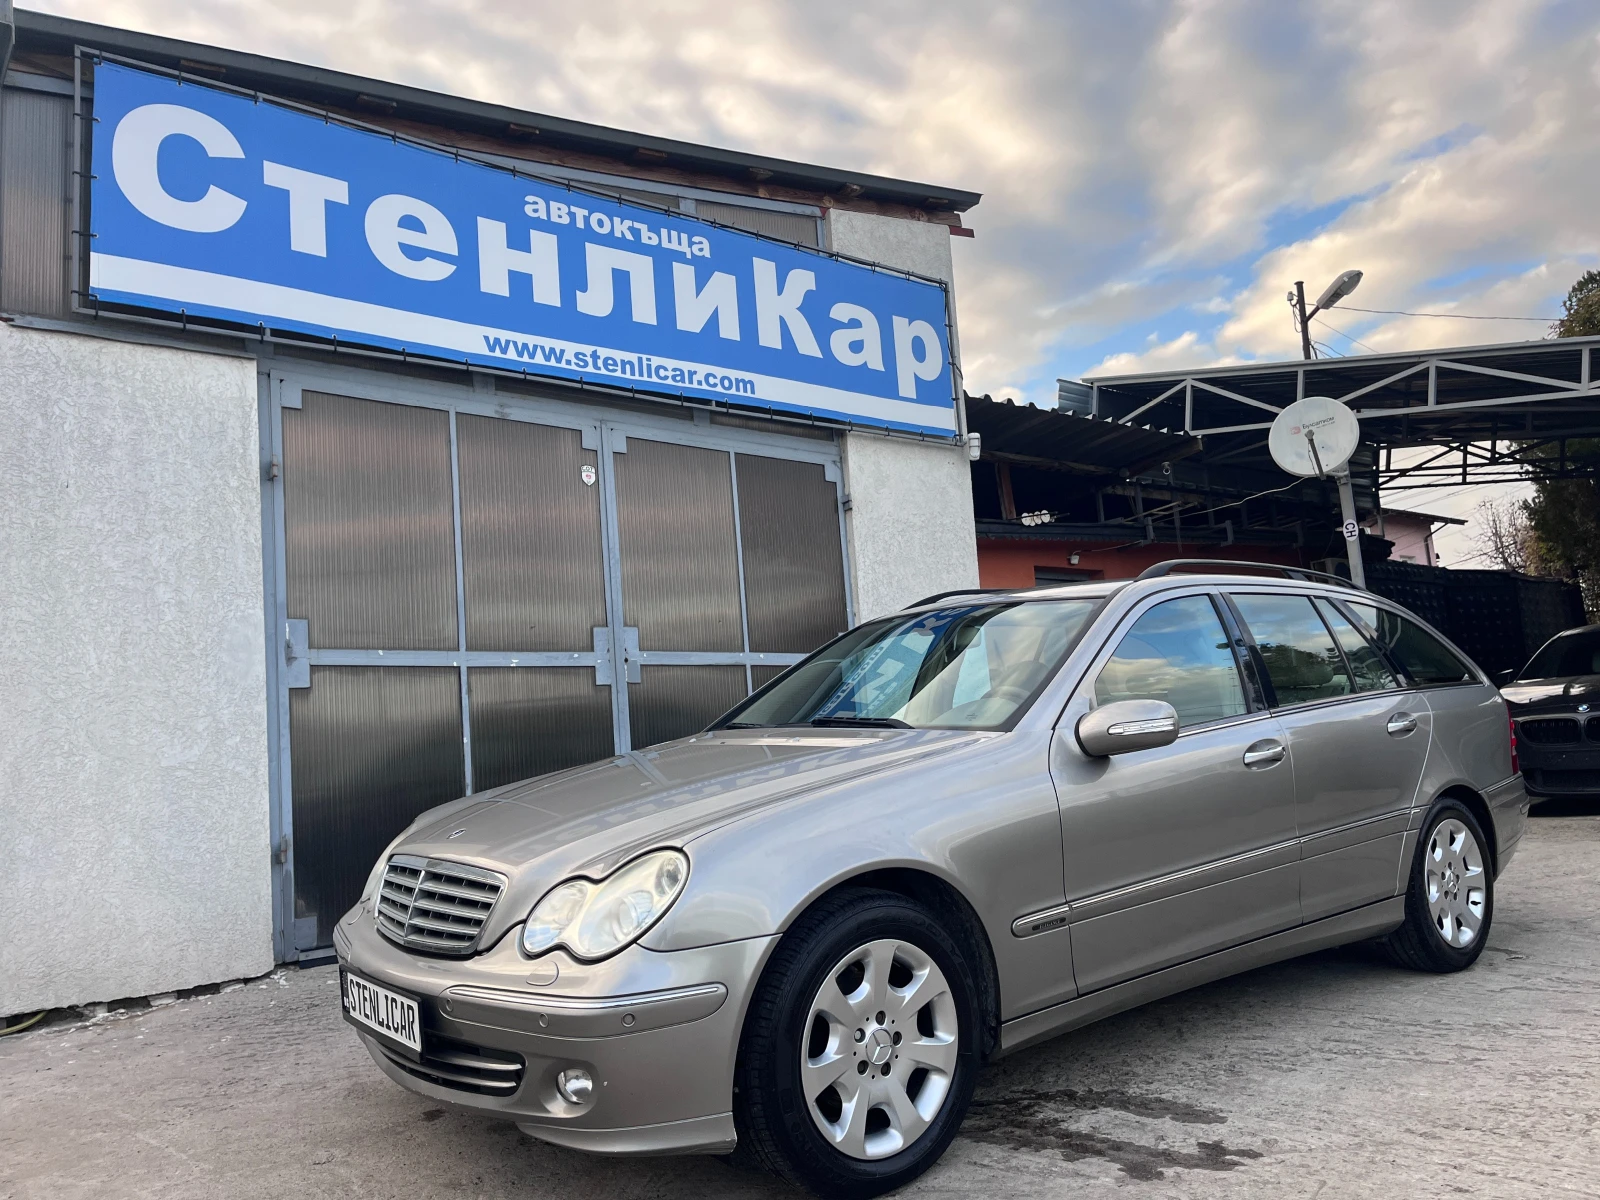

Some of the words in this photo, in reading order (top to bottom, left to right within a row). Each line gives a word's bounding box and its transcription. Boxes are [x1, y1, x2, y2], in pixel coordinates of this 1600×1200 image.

[111, 103, 943, 399] СтенлиКар
[524, 195, 712, 259] автокъща
[483, 335, 756, 395] www.stenlicar.com
[1345, 522, 1357, 538] CH
[349, 978, 417, 1044] STENLICAR
